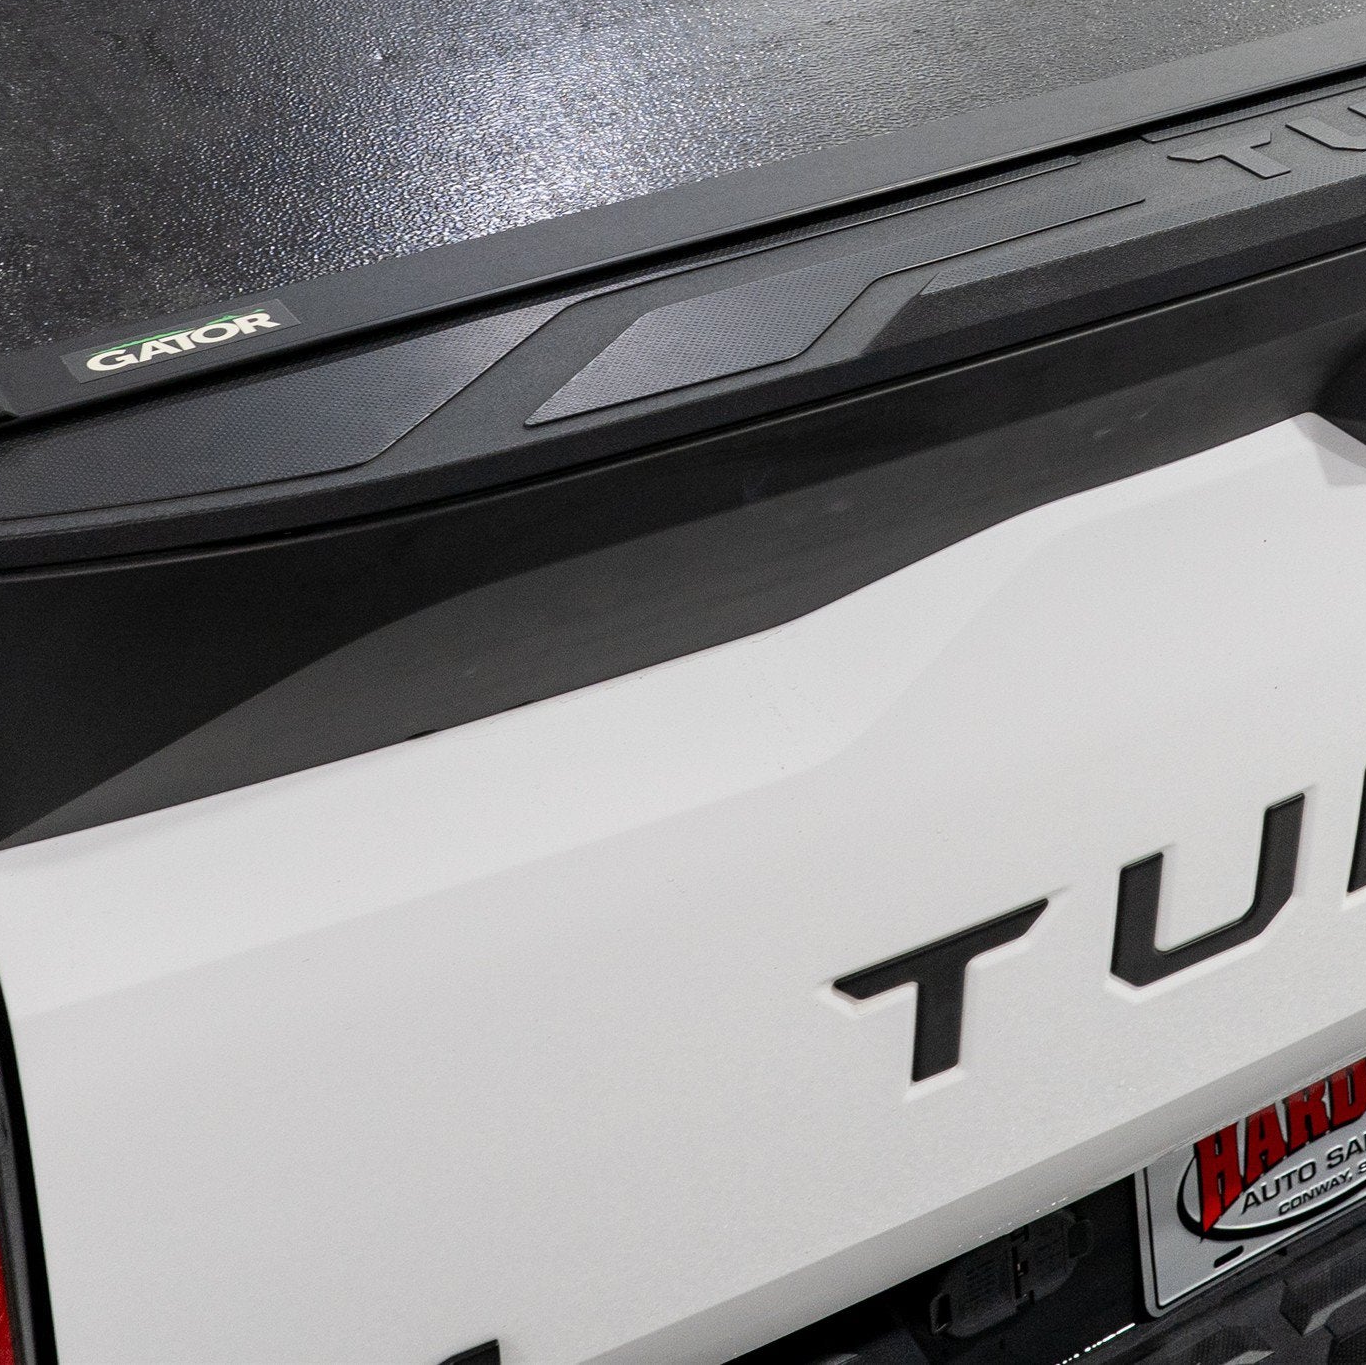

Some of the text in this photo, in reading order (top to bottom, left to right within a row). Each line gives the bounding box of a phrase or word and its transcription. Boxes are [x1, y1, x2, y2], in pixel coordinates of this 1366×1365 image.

[86, 312, 281, 372] GATOR
[1241, 1161, 1317, 1215] AUTO
[1277, 1168, 1353, 1216] CONWAY,
